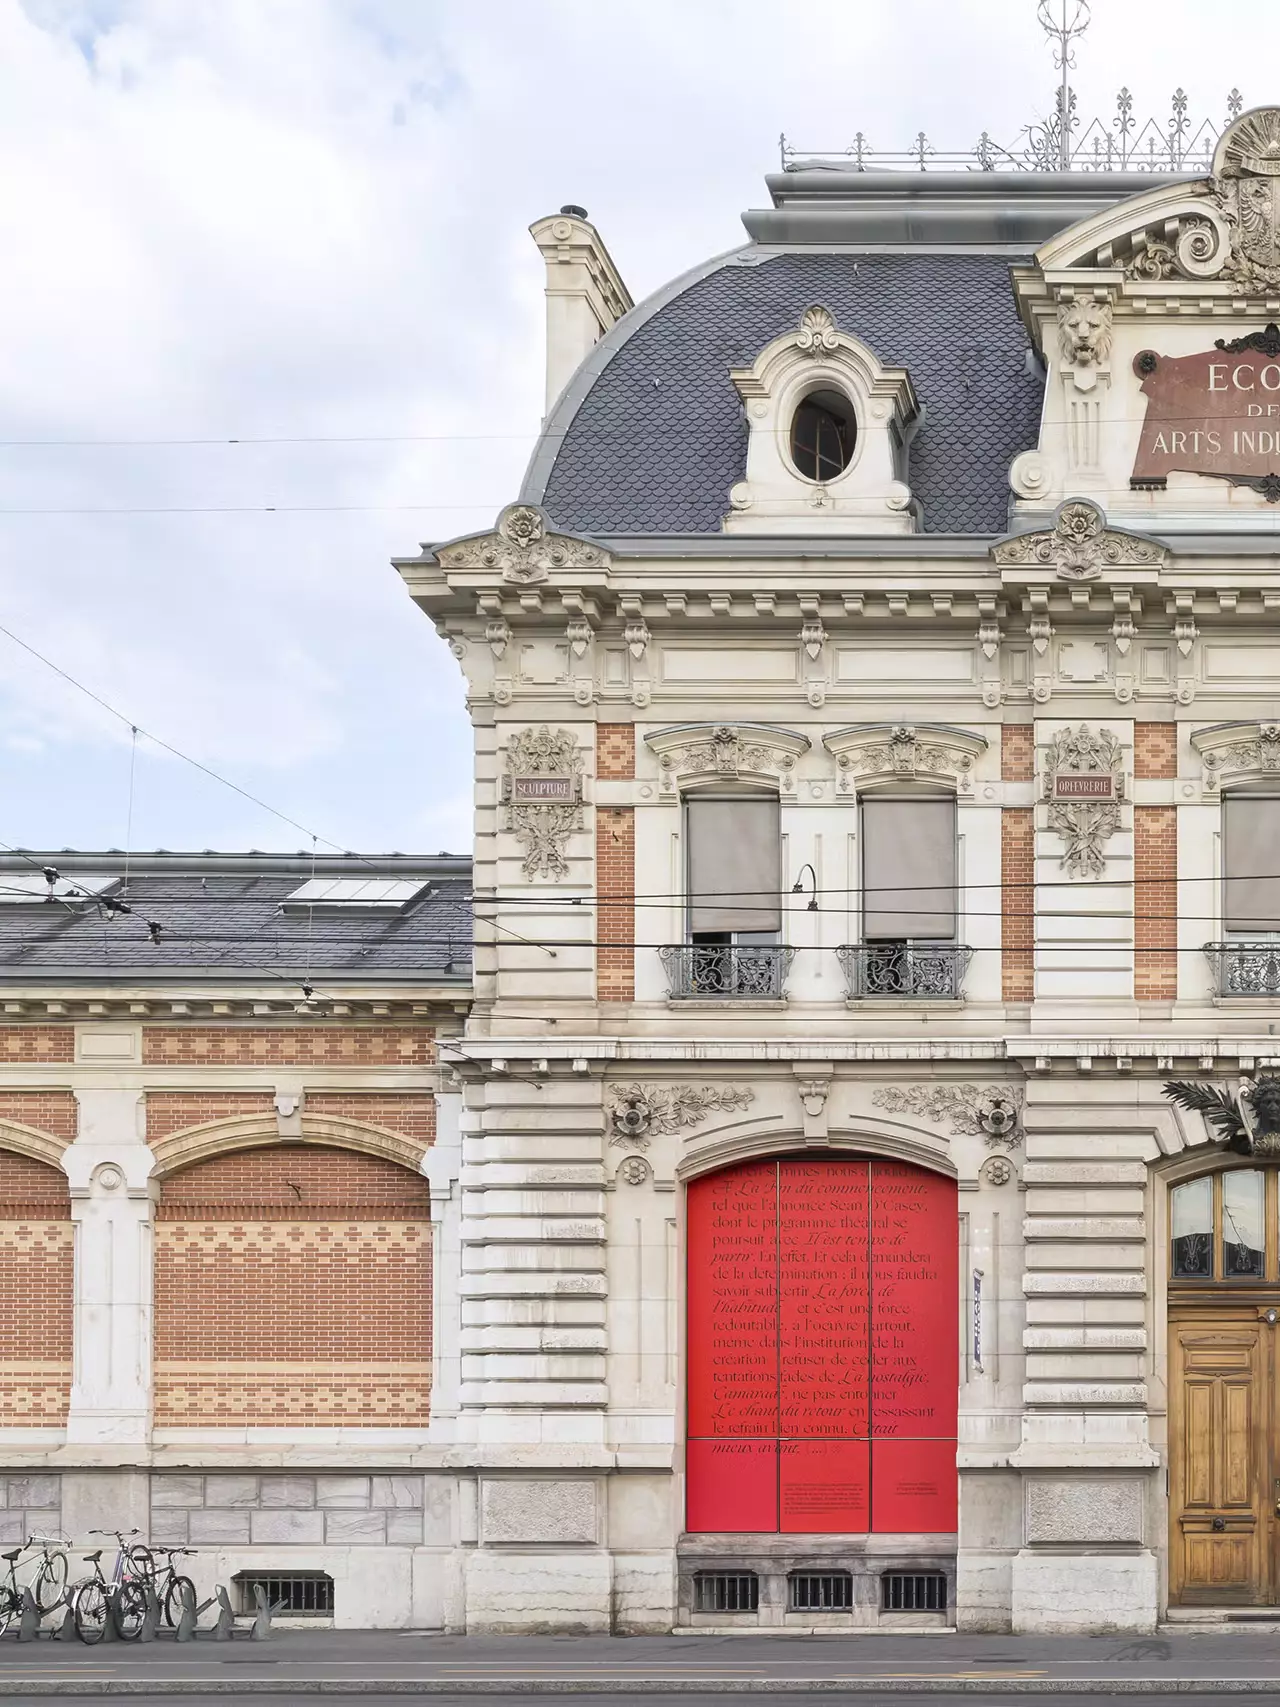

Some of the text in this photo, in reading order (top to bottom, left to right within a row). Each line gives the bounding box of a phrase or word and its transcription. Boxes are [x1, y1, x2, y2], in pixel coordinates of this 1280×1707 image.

[1152, 431, 1222, 454] ARTS
[516, 782, 569, 797] SCULPTURE
[769, 1236, 799, 1245] aec
[754, 1284, 810, 1297] subertir
